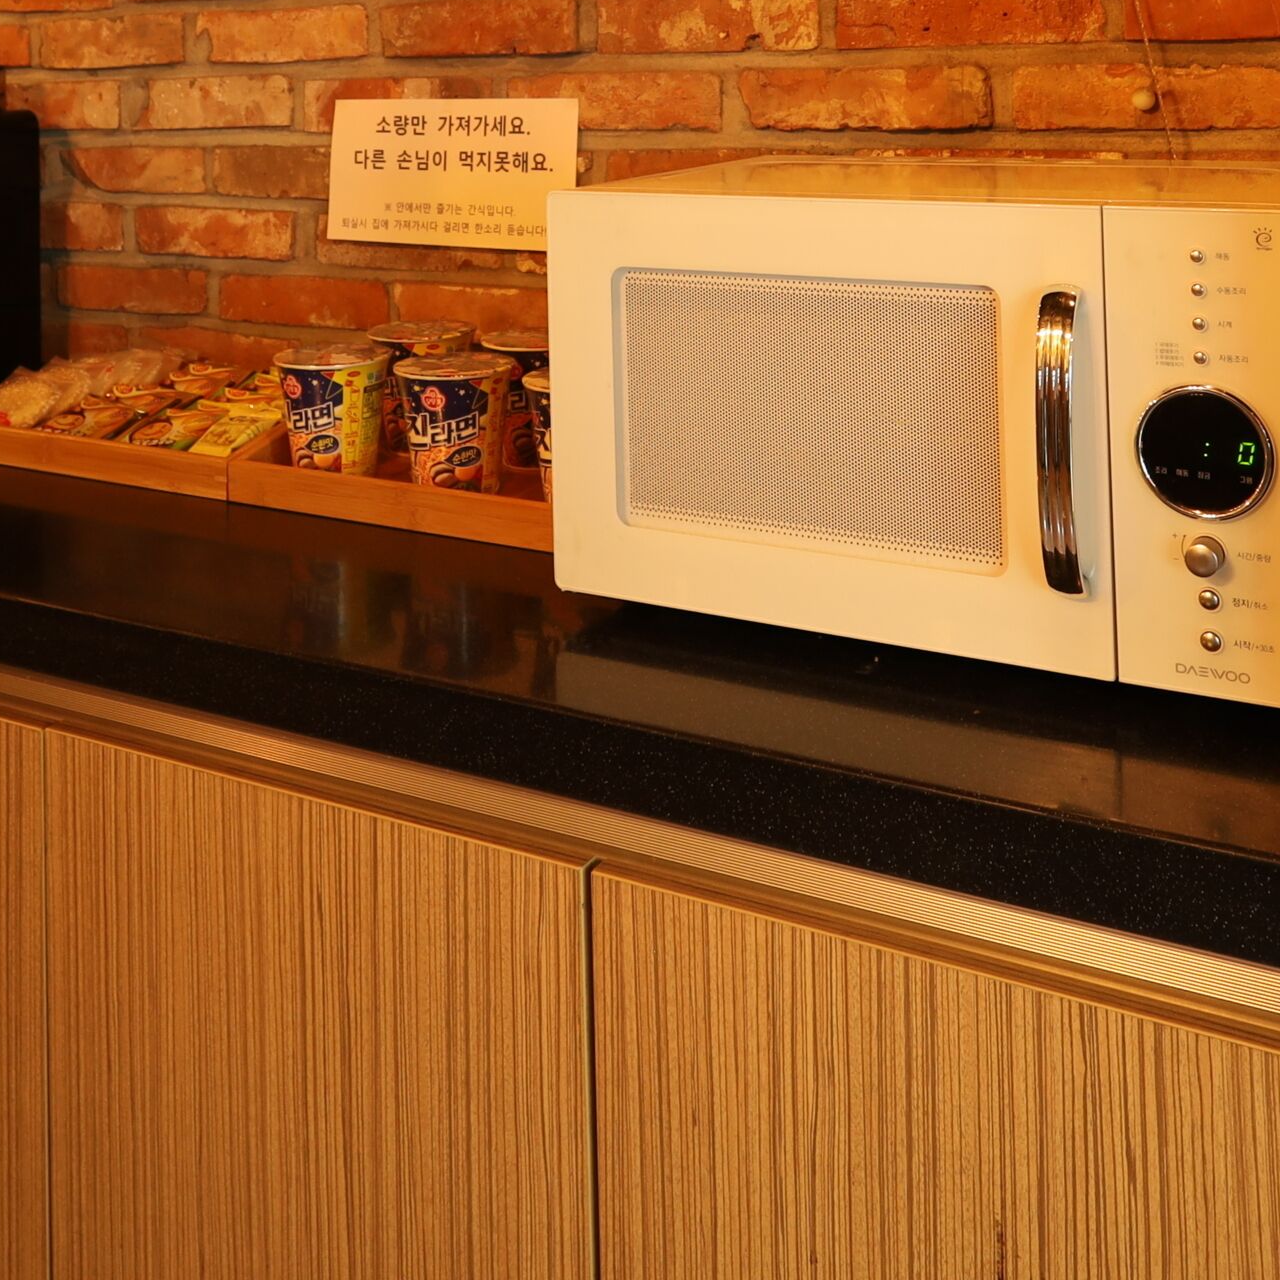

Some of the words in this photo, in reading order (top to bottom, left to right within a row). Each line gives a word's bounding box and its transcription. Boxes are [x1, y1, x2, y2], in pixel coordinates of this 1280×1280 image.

[375, 114, 428, 136] 소량만
[437, 114, 531, 138] 가져가세요.
[353, 149, 387, 170] 다른
[396, 149, 448, 172] 손님이
[458, 151, 554, 173] 먹지못해요.
[396, 201, 432, 214] 안에서만
[436, 202, 463, 216] 즐기는
[474, 222, 502, 235] 한소리
[285, 400, 336, 434] 라면
[404, 410, 480, 452] 진라면
[452, 447, 478, 466] 순한맛
[1237, 441, 1256, 466] 0
[1175, 662, 1251, 684] DAEWOO
